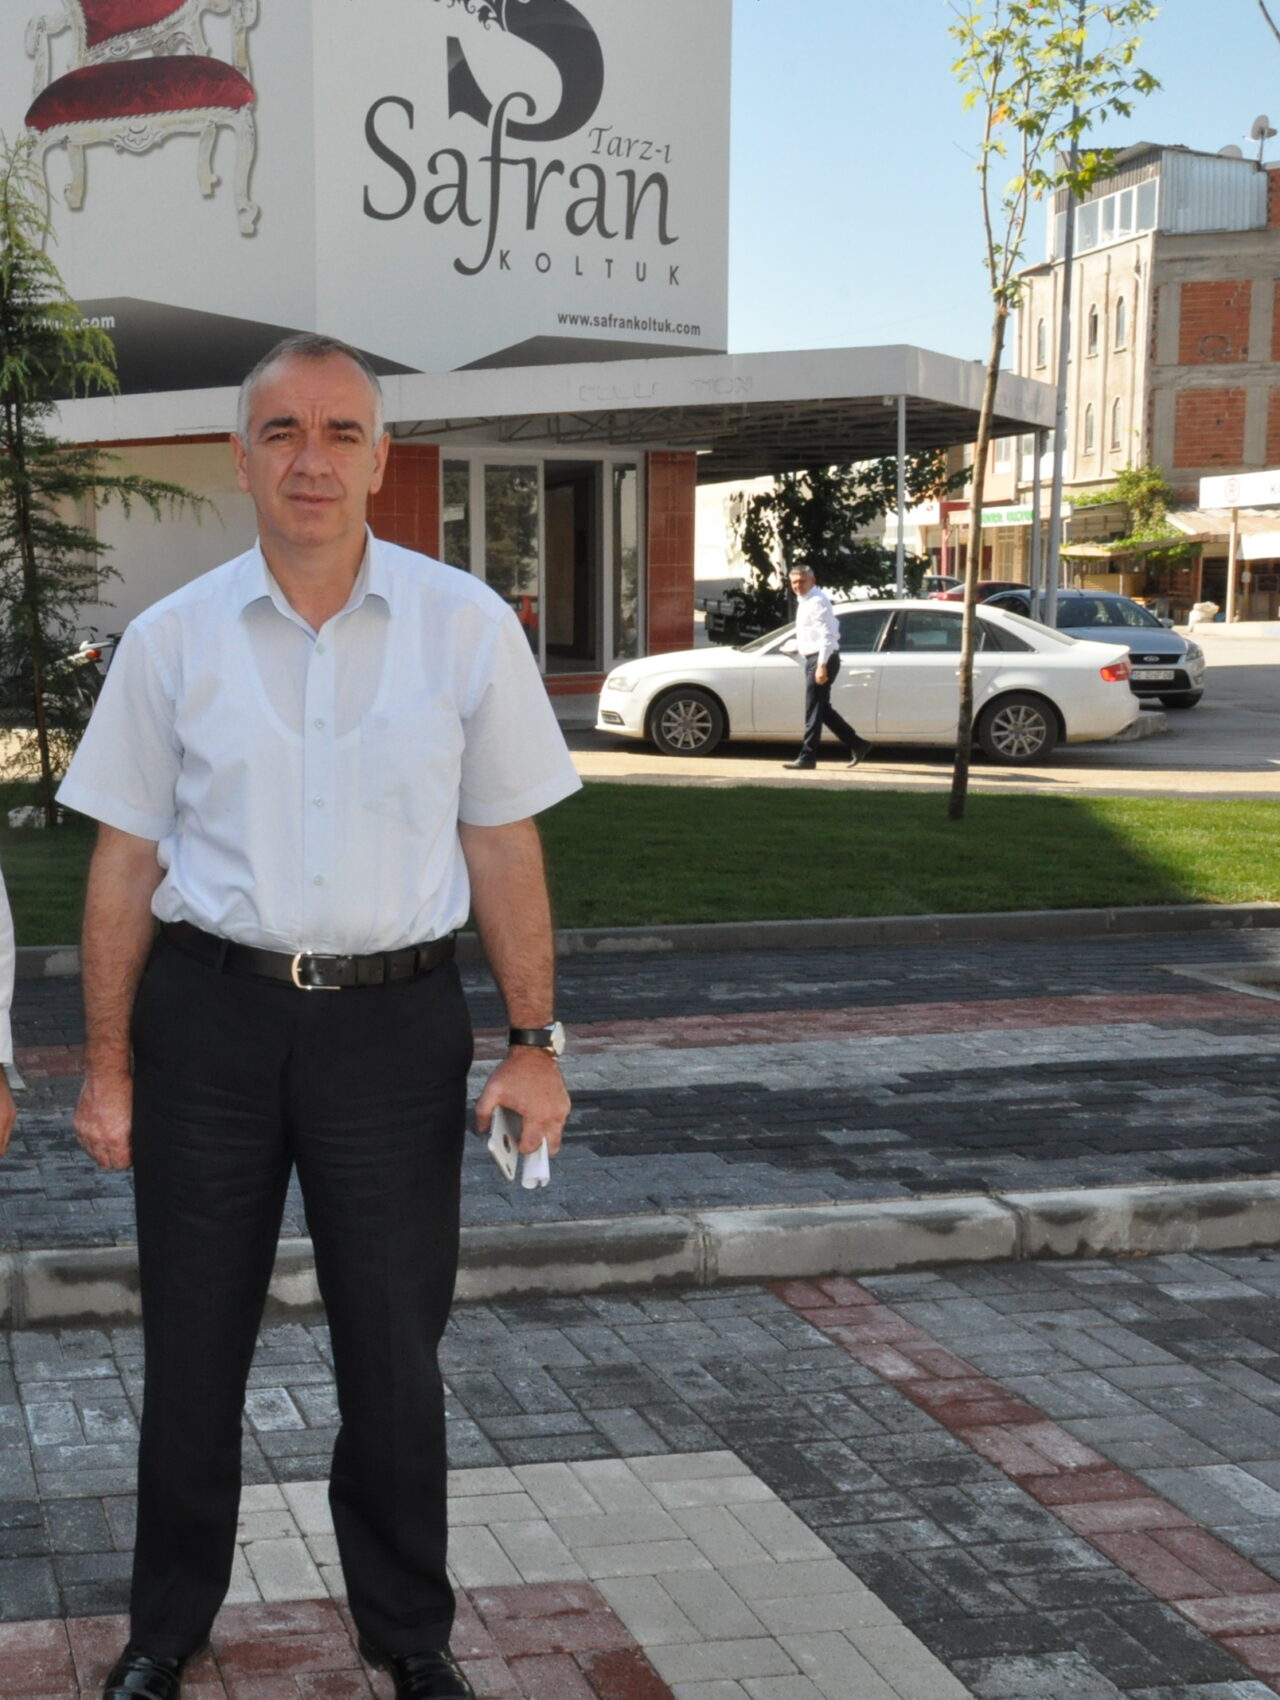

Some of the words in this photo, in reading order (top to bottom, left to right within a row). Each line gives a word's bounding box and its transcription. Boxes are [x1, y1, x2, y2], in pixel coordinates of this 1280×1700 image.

[362, 91, 680, 276] Safran
[498, 249, 681, 286] KOLTUK
[557, 312, 701, 336] www.safrankoltuk.com
